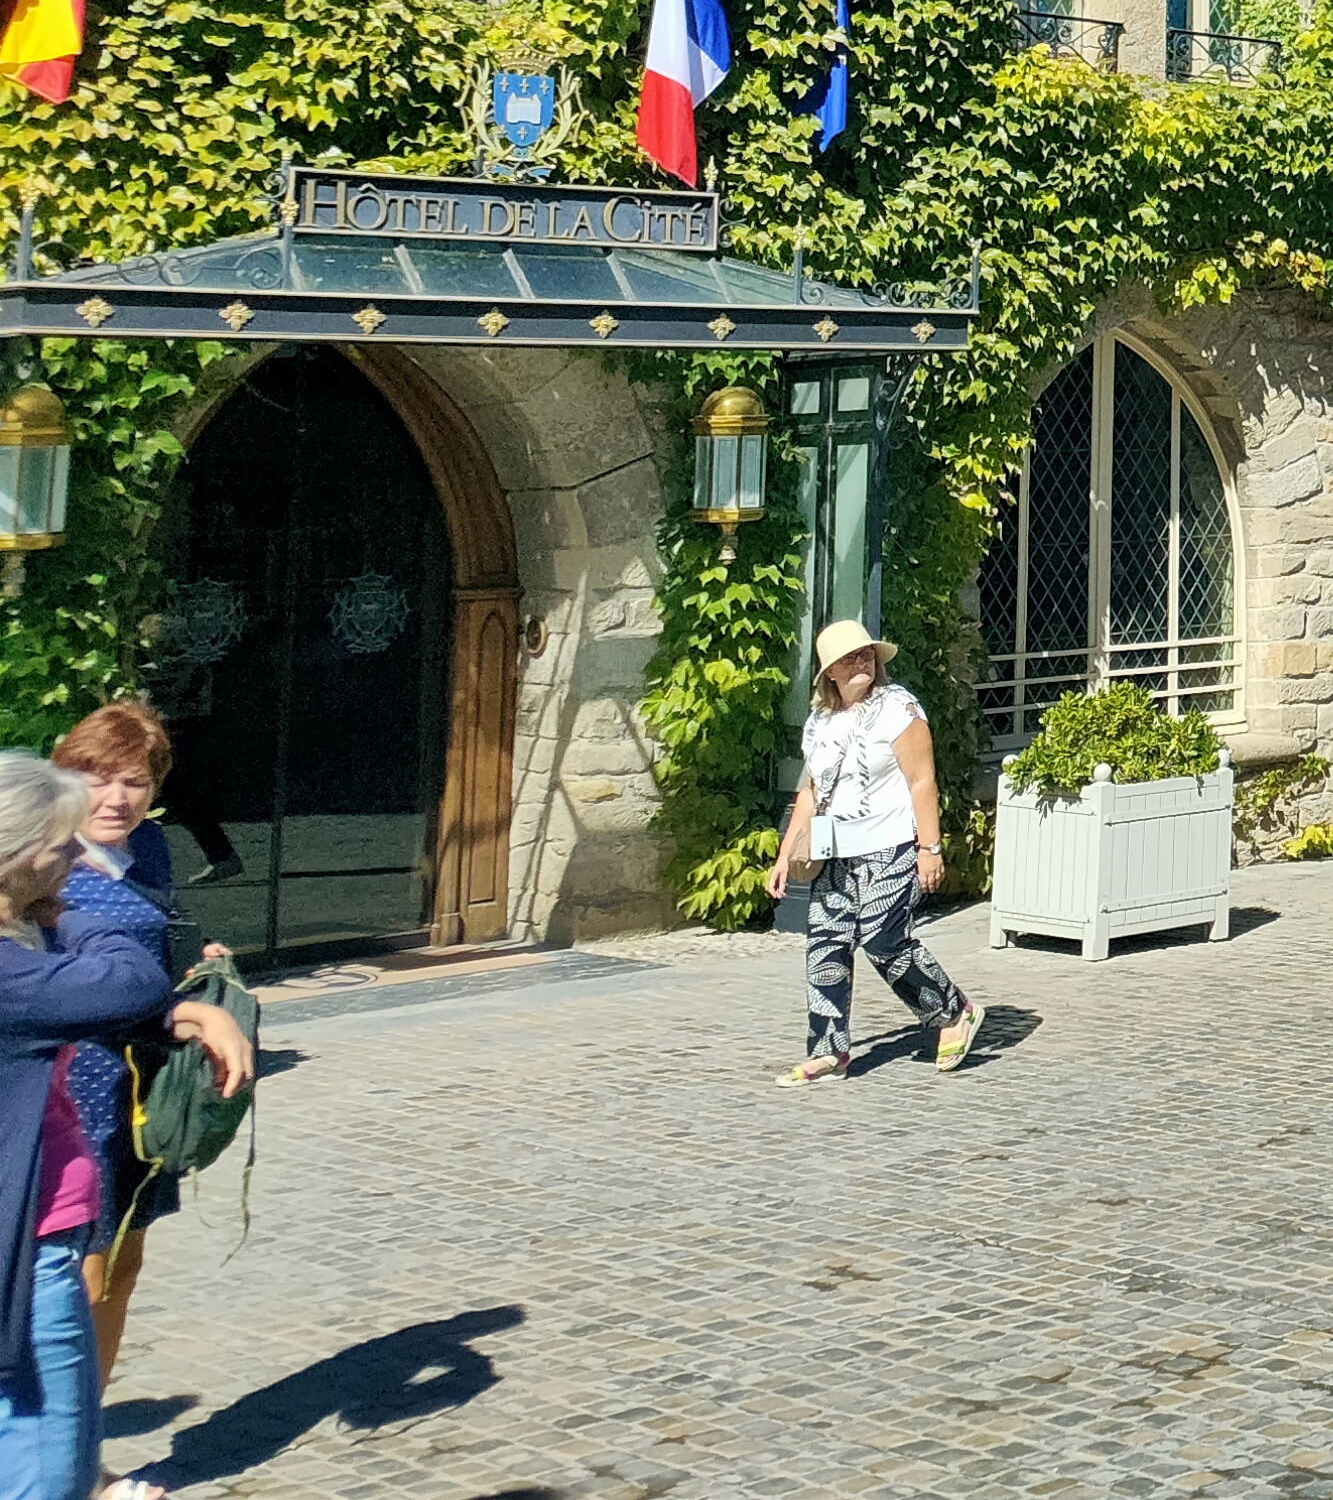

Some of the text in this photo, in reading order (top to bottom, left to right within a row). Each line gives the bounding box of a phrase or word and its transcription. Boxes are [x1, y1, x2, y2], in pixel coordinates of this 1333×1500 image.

[297, 178, 468, 235] HÔTEL
[478, 199, 537, 238] DE
[544, 201, 600, 240] LA
